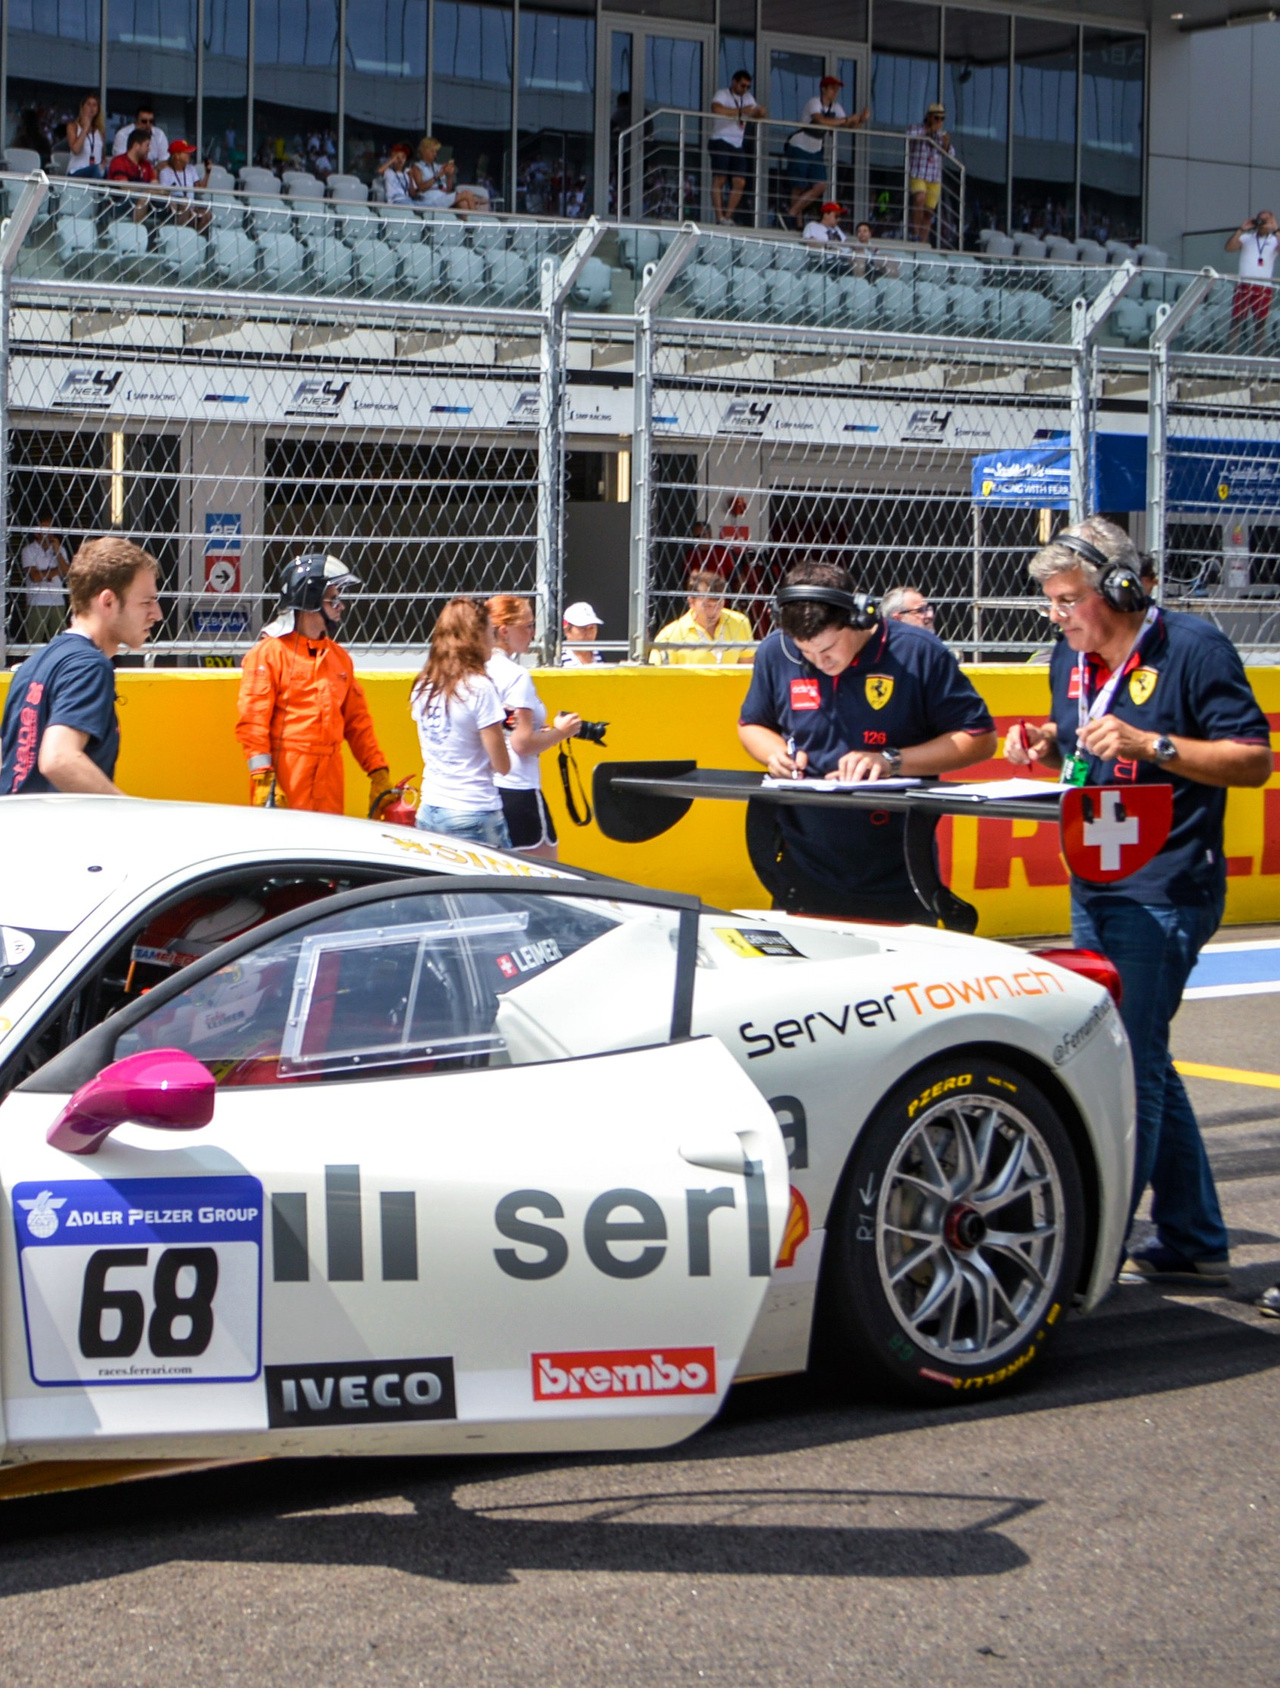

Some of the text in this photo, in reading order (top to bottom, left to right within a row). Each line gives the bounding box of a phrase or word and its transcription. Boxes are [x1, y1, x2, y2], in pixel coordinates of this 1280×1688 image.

[59, 368, 123, 395] F4
[292, 379, 351, 406] F4
[722, 402, 773, 425] F4
[906, 409, 953, 432] F4
[862, 730, 887, 745] 126
[738, 966, 1066, 1060] ServerTown.ch
[65, 1207, 258, 1227] ADLER PELZER GROUP
[78, 1246, 219, 1359] 68
[98, 1364, 193, 1377] races.ferrari.com
[538, 1353, 709, 1395] brembo
[281, 1371, 443, 1413] IVECO
